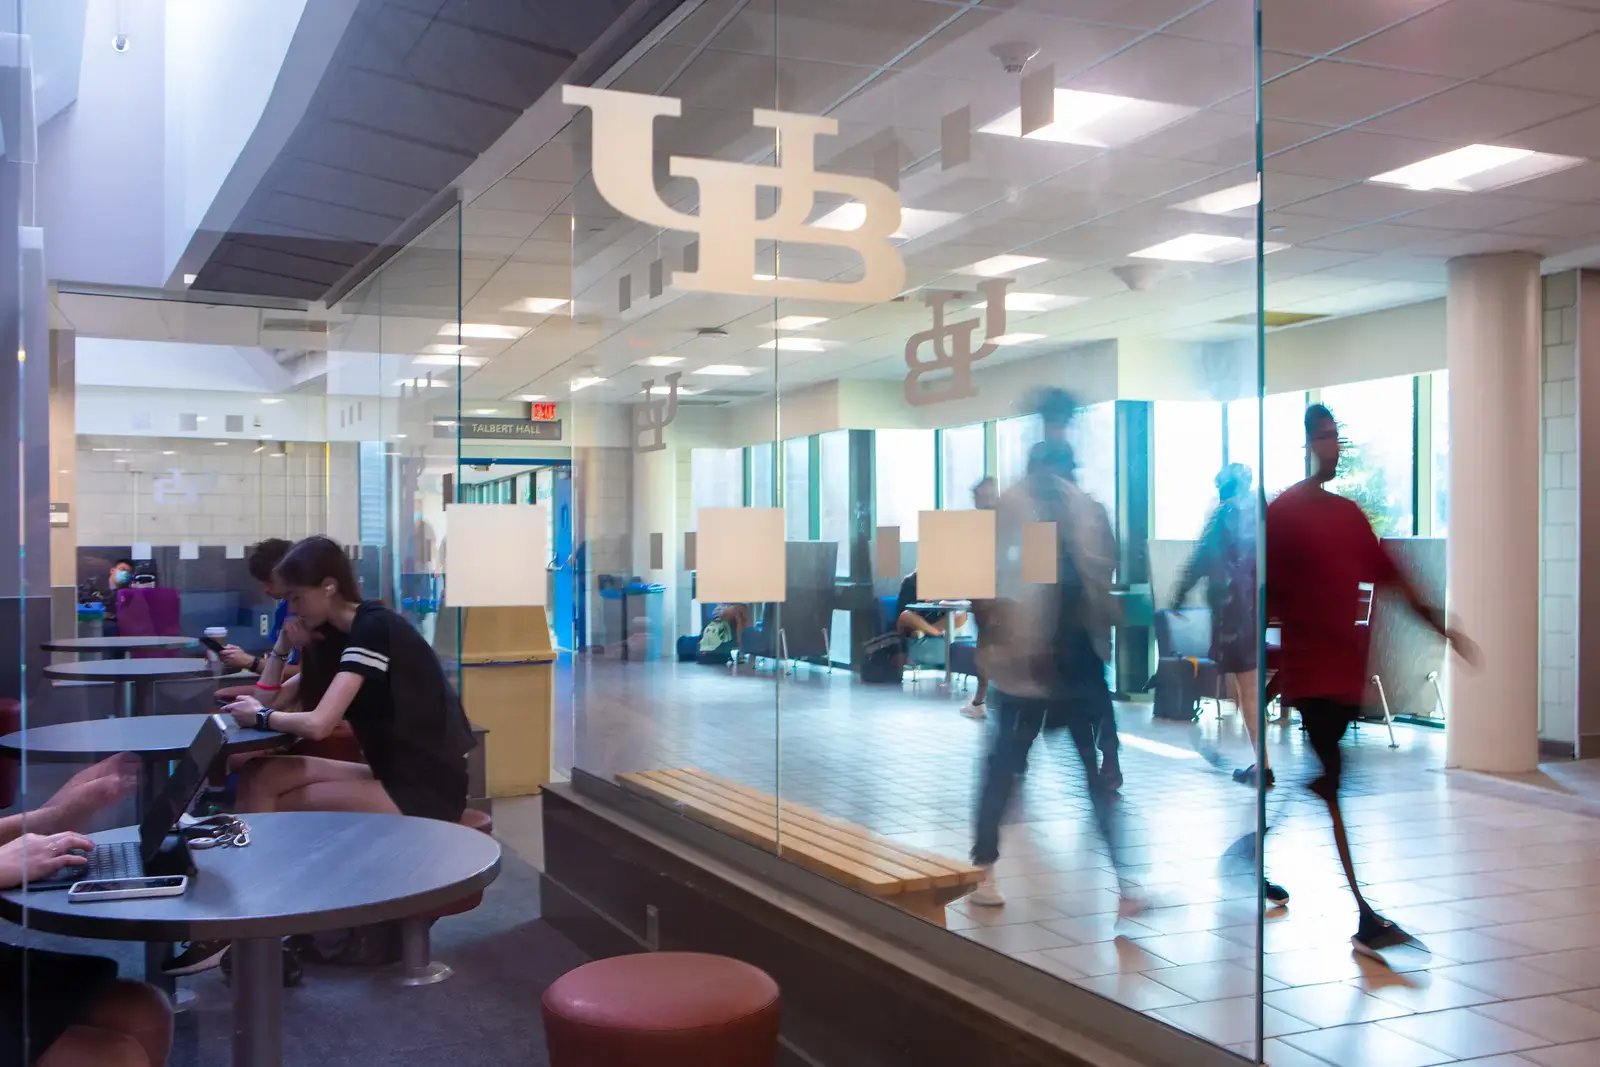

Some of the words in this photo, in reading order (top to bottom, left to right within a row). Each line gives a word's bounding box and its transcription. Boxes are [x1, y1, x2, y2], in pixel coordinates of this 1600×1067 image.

[562, 84, 906, 303] UB
[534, 404, 556, 420] EXIT
[472, 424, 513, 433] TALBERT
[516, 425, 540, 434] HALL
